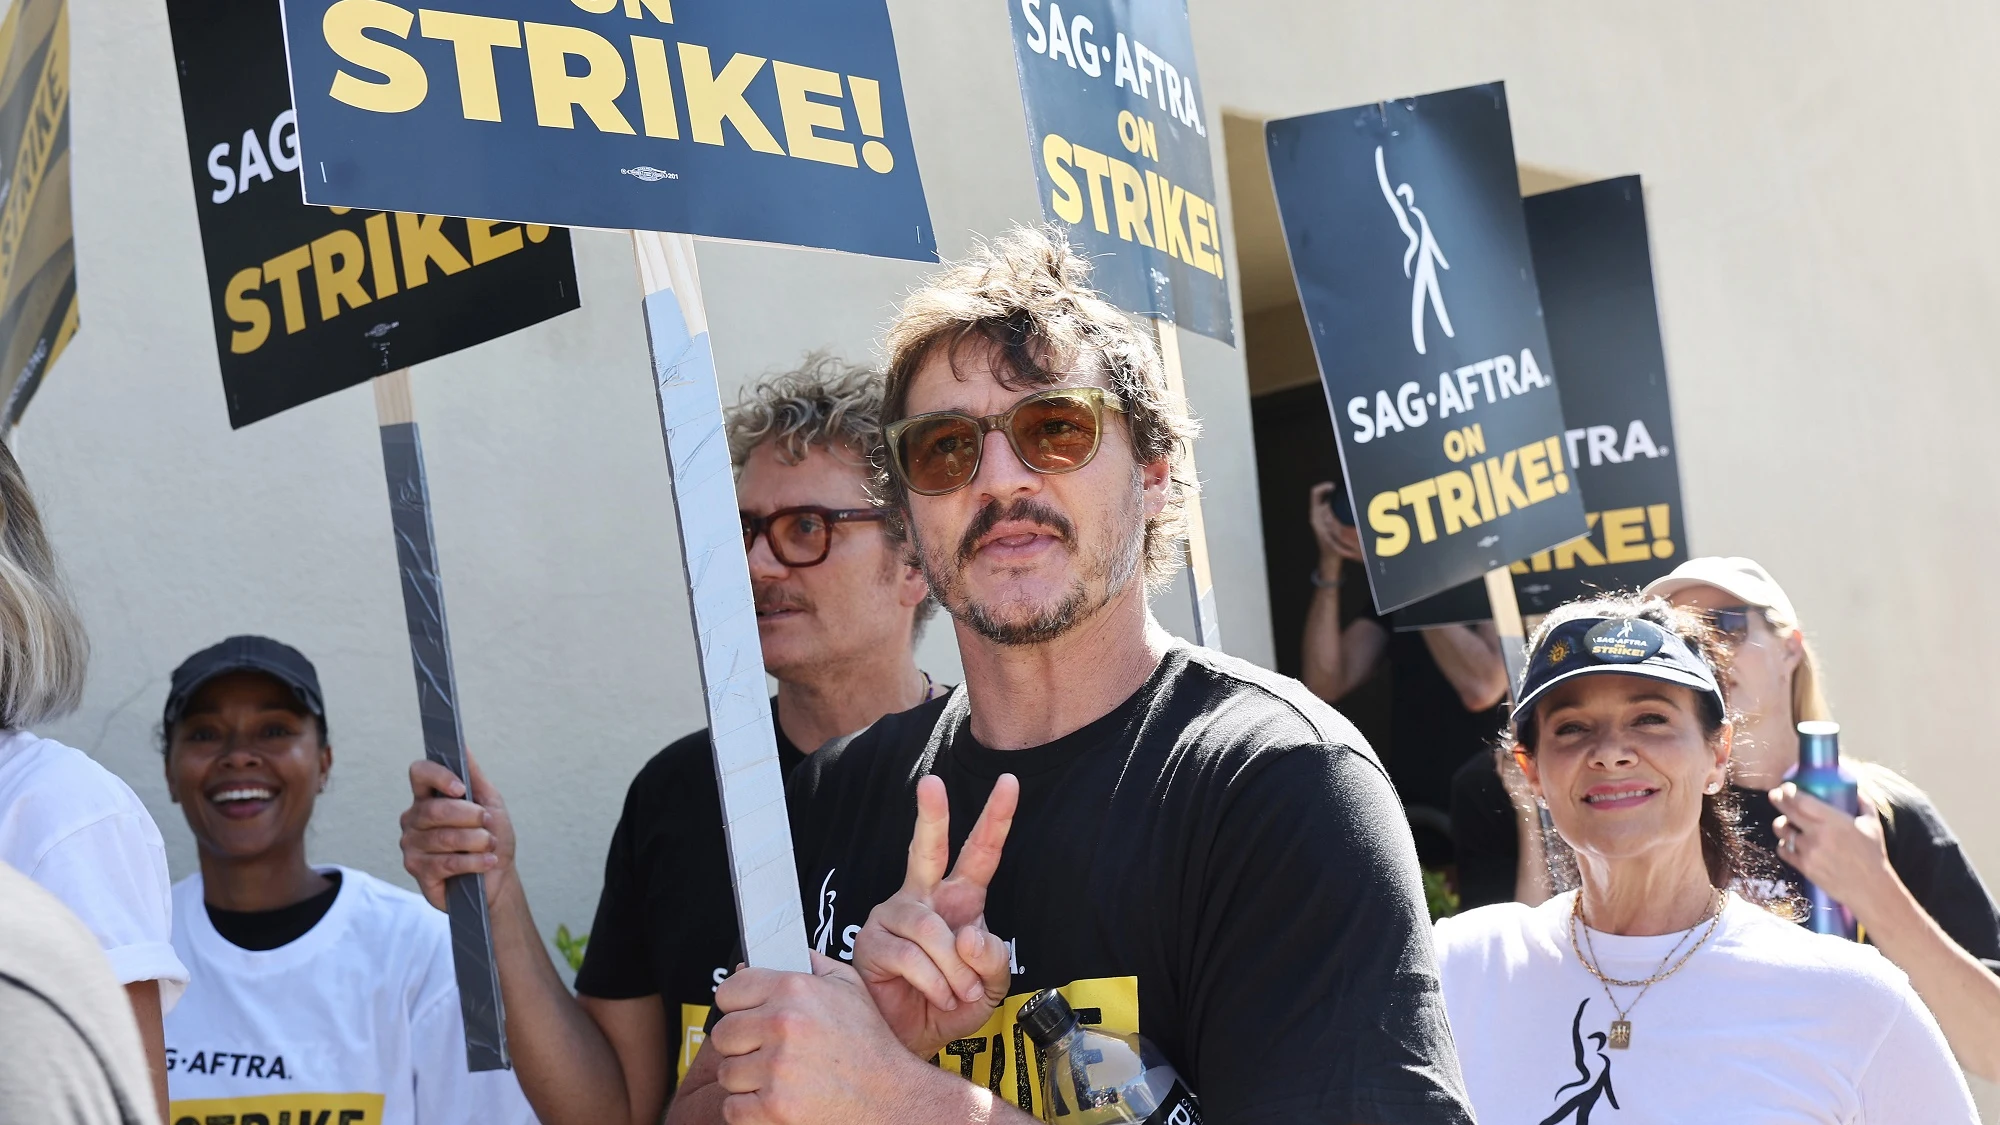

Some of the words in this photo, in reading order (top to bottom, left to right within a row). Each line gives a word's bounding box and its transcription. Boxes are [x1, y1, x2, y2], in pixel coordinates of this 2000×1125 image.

[323, 0, 894, 173] STRIKE!
[1117, 110, 1158, 161] ON
[1042, 133, 1224, 280] STRIKE!
[1367, 437, 1569, 557] STRIKE!
[1443, 423, 1486, 463] ON
